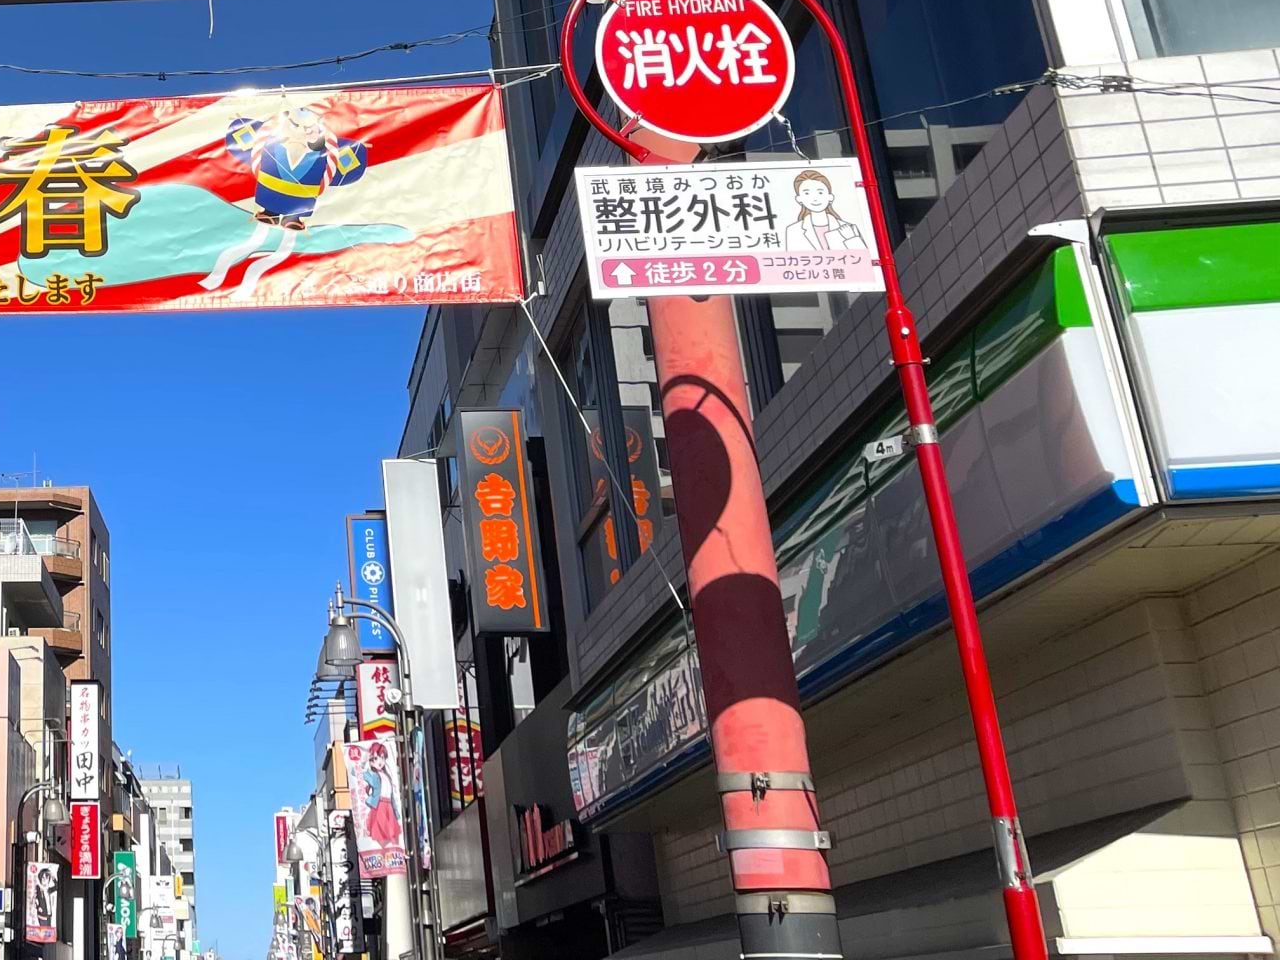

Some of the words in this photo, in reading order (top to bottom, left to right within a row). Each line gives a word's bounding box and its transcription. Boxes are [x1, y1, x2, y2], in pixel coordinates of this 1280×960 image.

[625, 0, 662, 17] FIRE
[617, 23, 777, 89] 消火栓
[591, 174, 771, 196] 武蔵境みつおか
[595, 192, 778, 236] 整形外科
[597, 233, 782, 253] リハビリテーション科
[763, 254, 862, 267] ココカラファイン
[874, 442, 895, 457] 4m
[365, 528, 376, 558] CLUB
[474, 472, 527, 610] 吉野家
[75, 751, 95, 794] 田中
